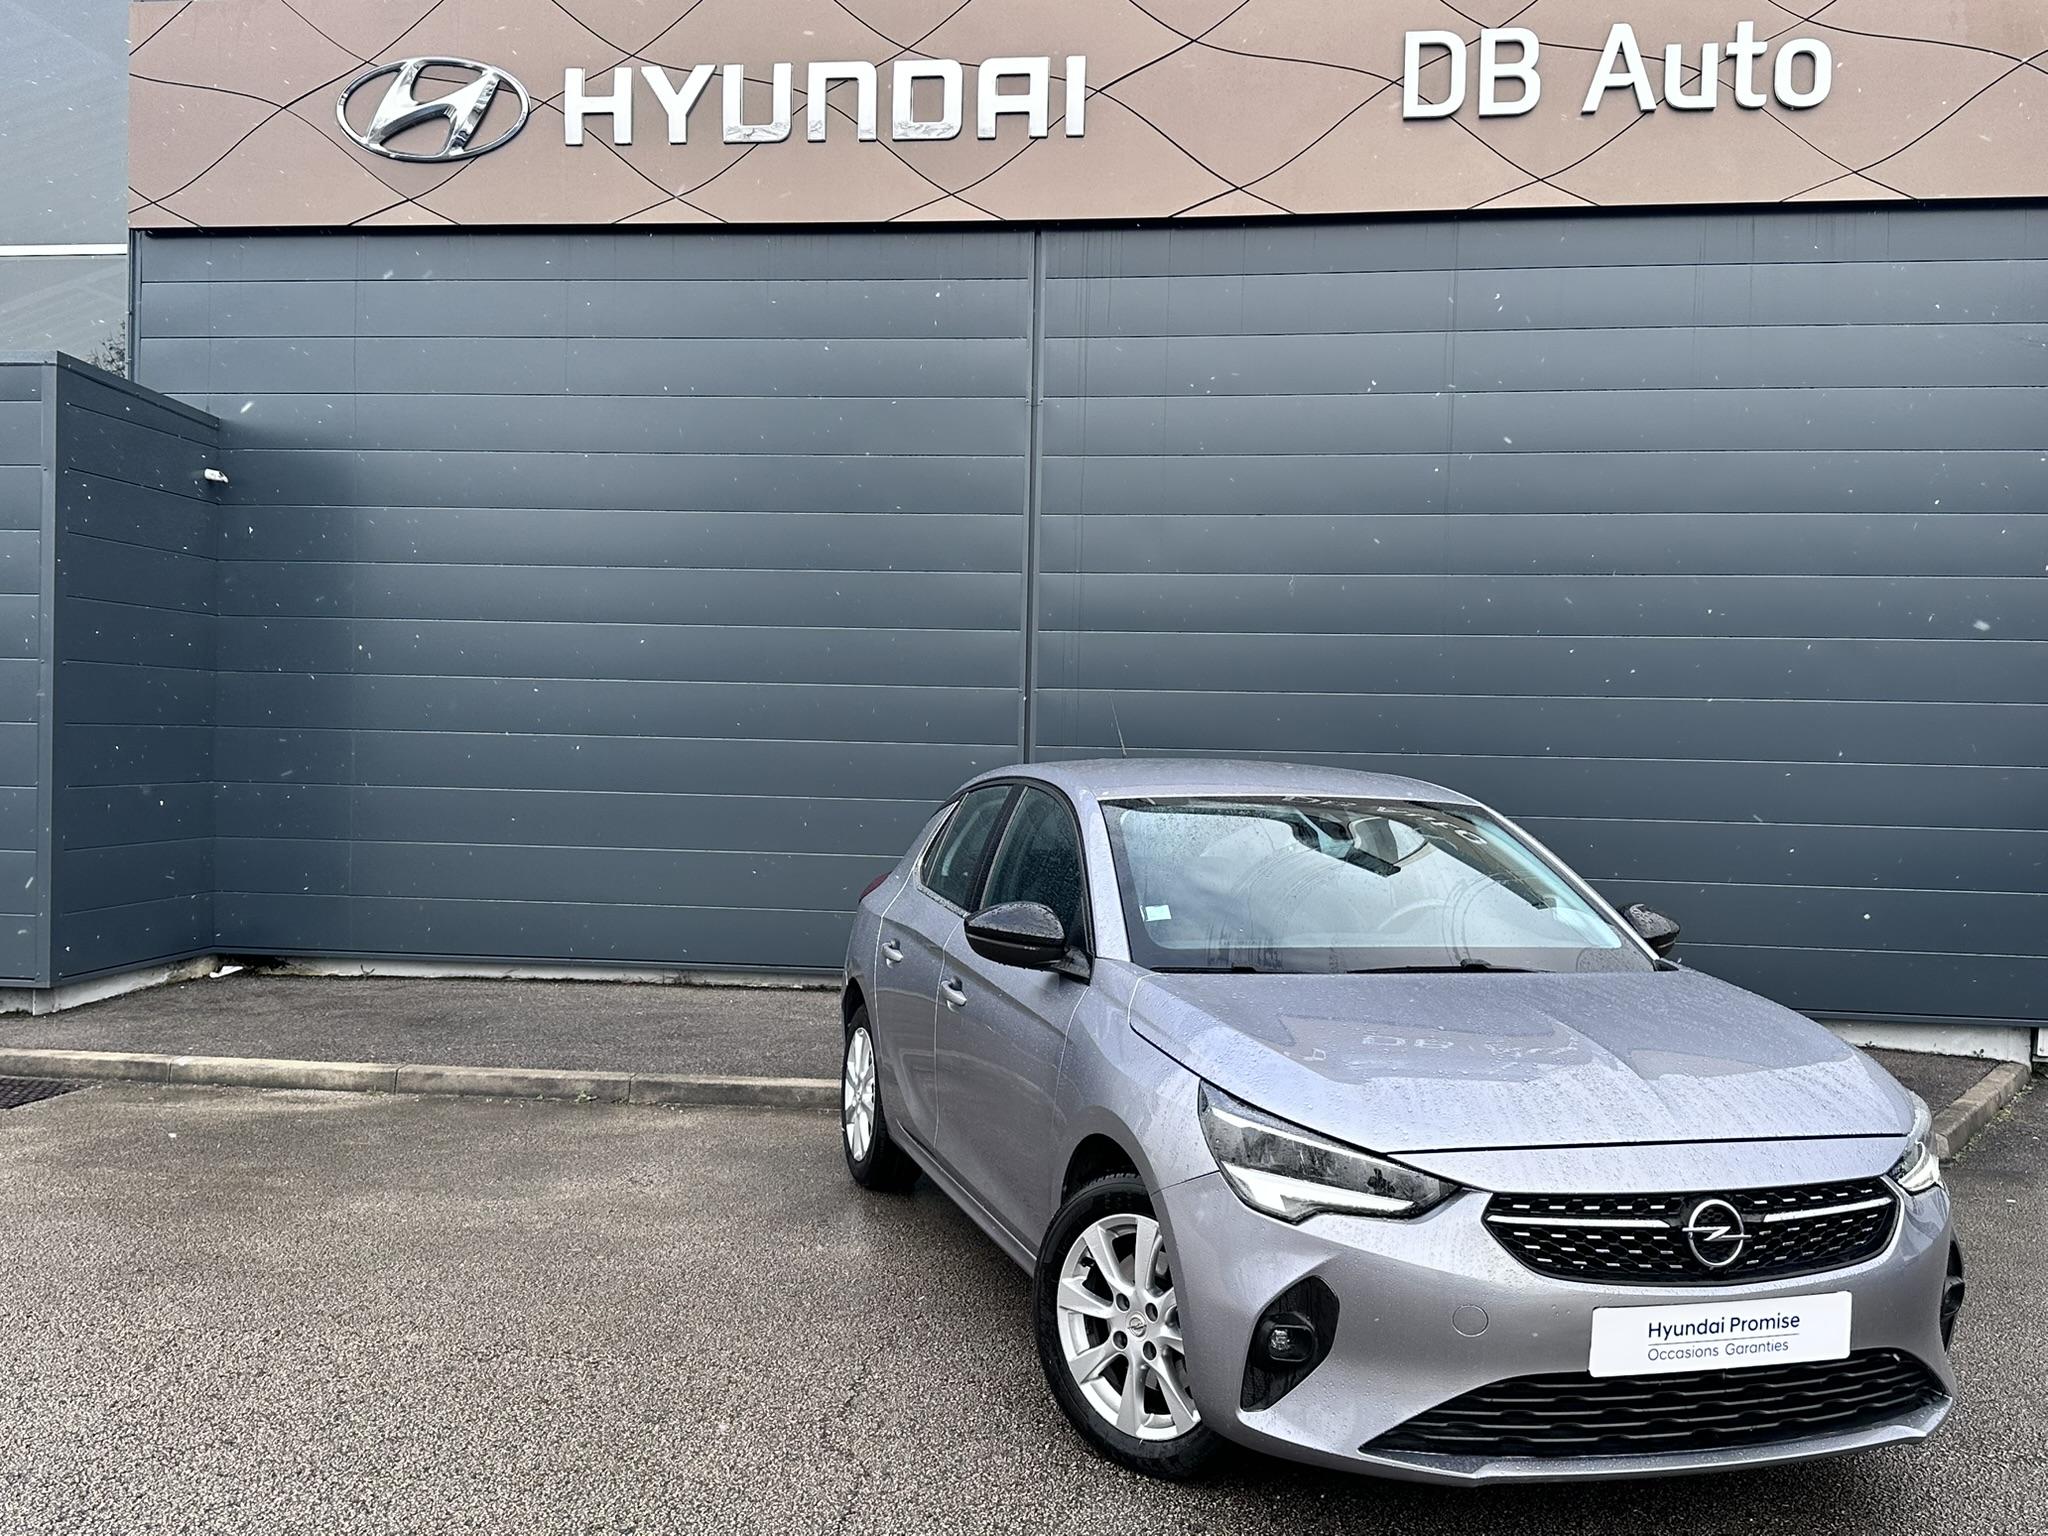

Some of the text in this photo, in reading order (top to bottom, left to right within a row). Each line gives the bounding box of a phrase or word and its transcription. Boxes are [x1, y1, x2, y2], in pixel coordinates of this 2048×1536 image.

[1403, 21, 1833, 120] DB Auto
[564, 56, 1087, 145] HYUNDAI
[1647, 1339, 1789, 1362] Occasions Garanties
[1648, 1312, 1800, 1341] Hyundai Promise
